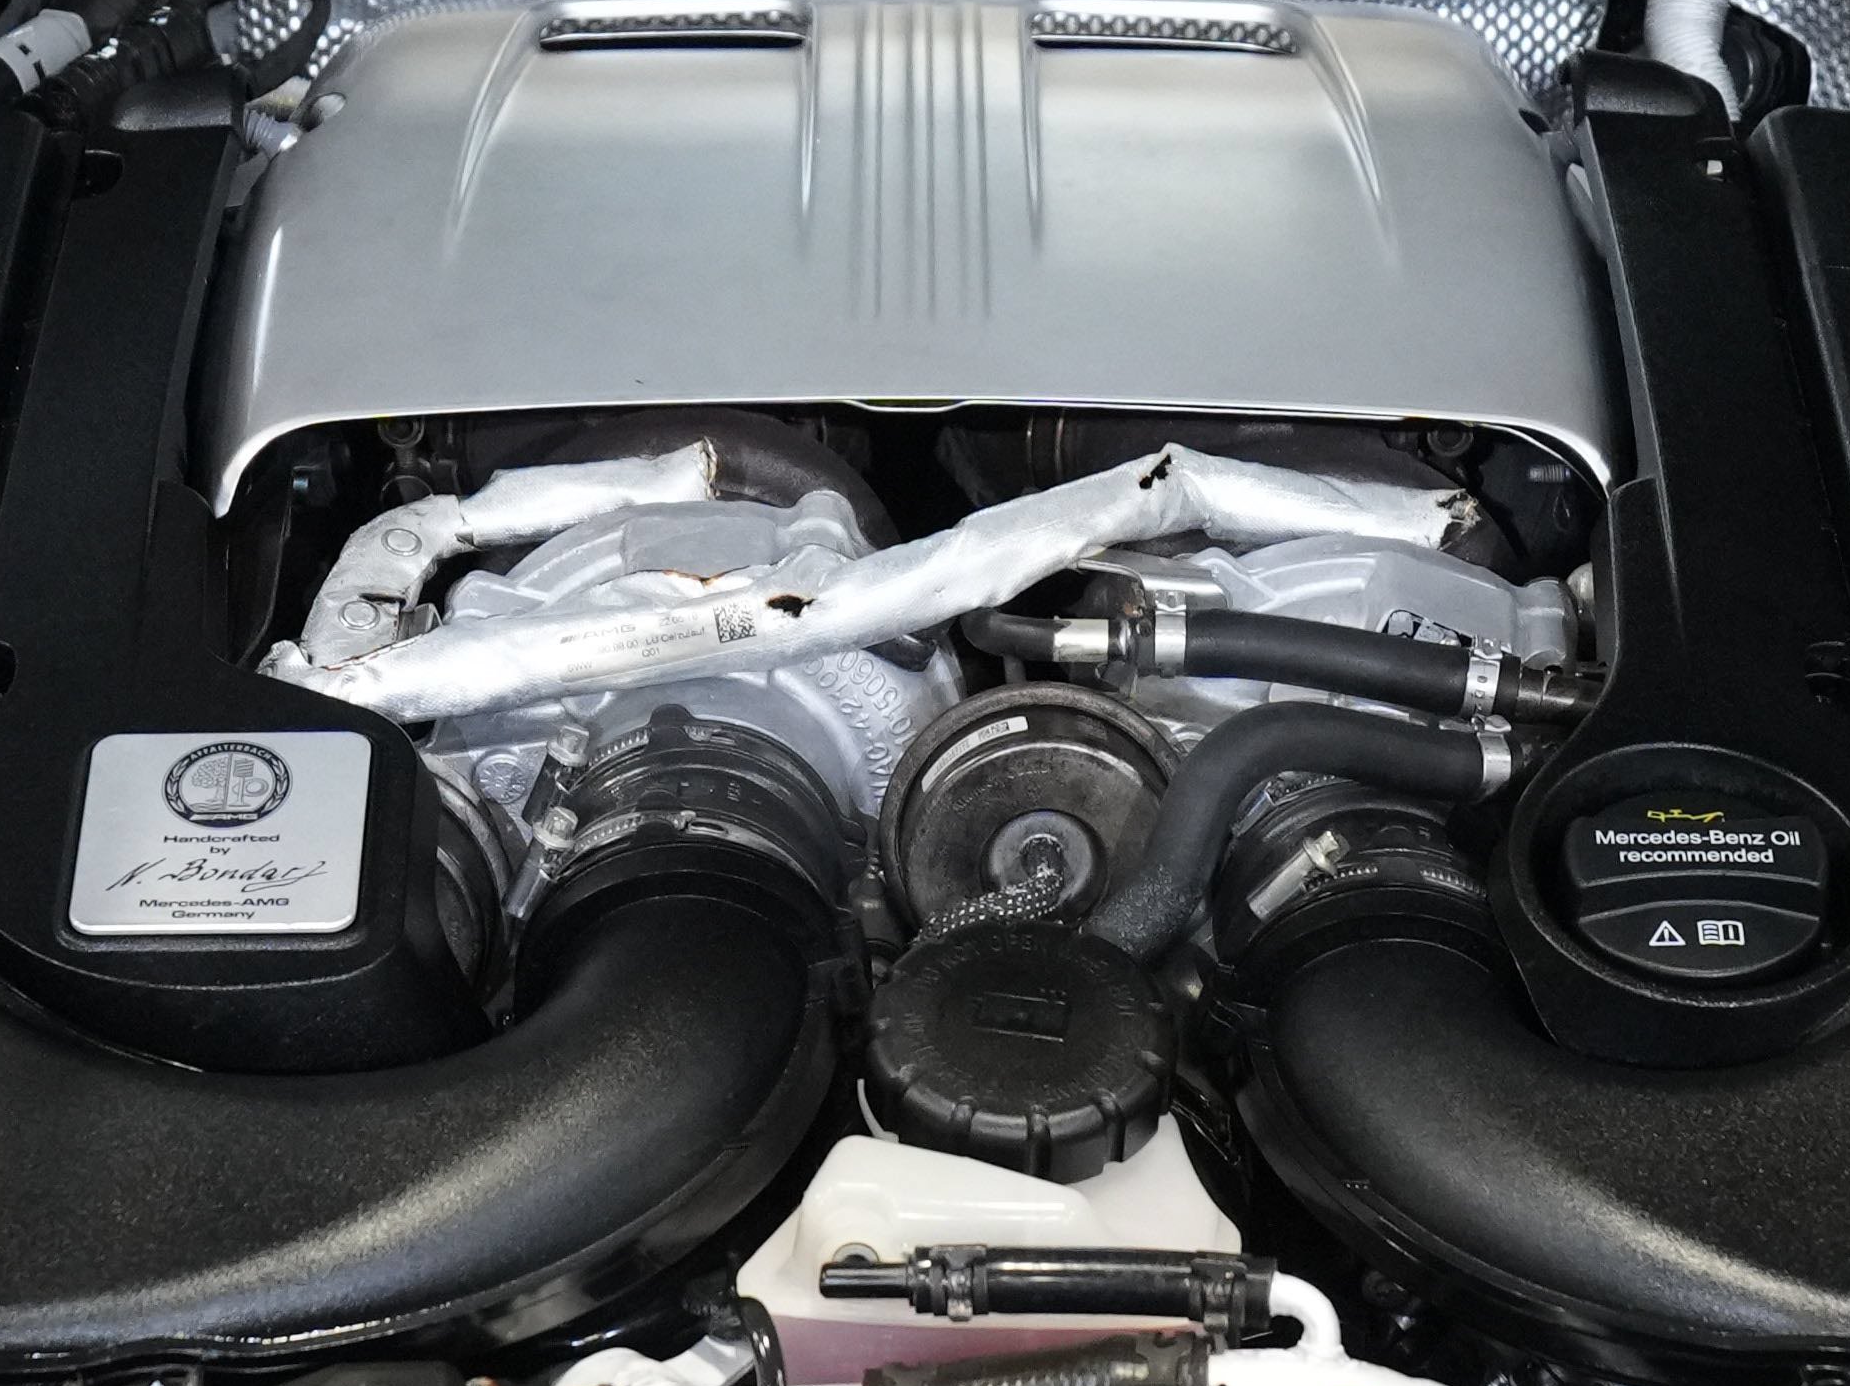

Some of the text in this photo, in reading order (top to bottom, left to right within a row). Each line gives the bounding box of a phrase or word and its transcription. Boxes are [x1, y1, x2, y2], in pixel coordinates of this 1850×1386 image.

[163, 834, 280, 843] Handcrafted
[1595, 829, 1801, 847] Mercedes-Benz Oil
[210, 845, 231, 856] by
[1619, 848, 1774, 865] recommended
[139, 898, 290, 908] Mercedes-AMG
[172, 910, 255, 920] Germany
